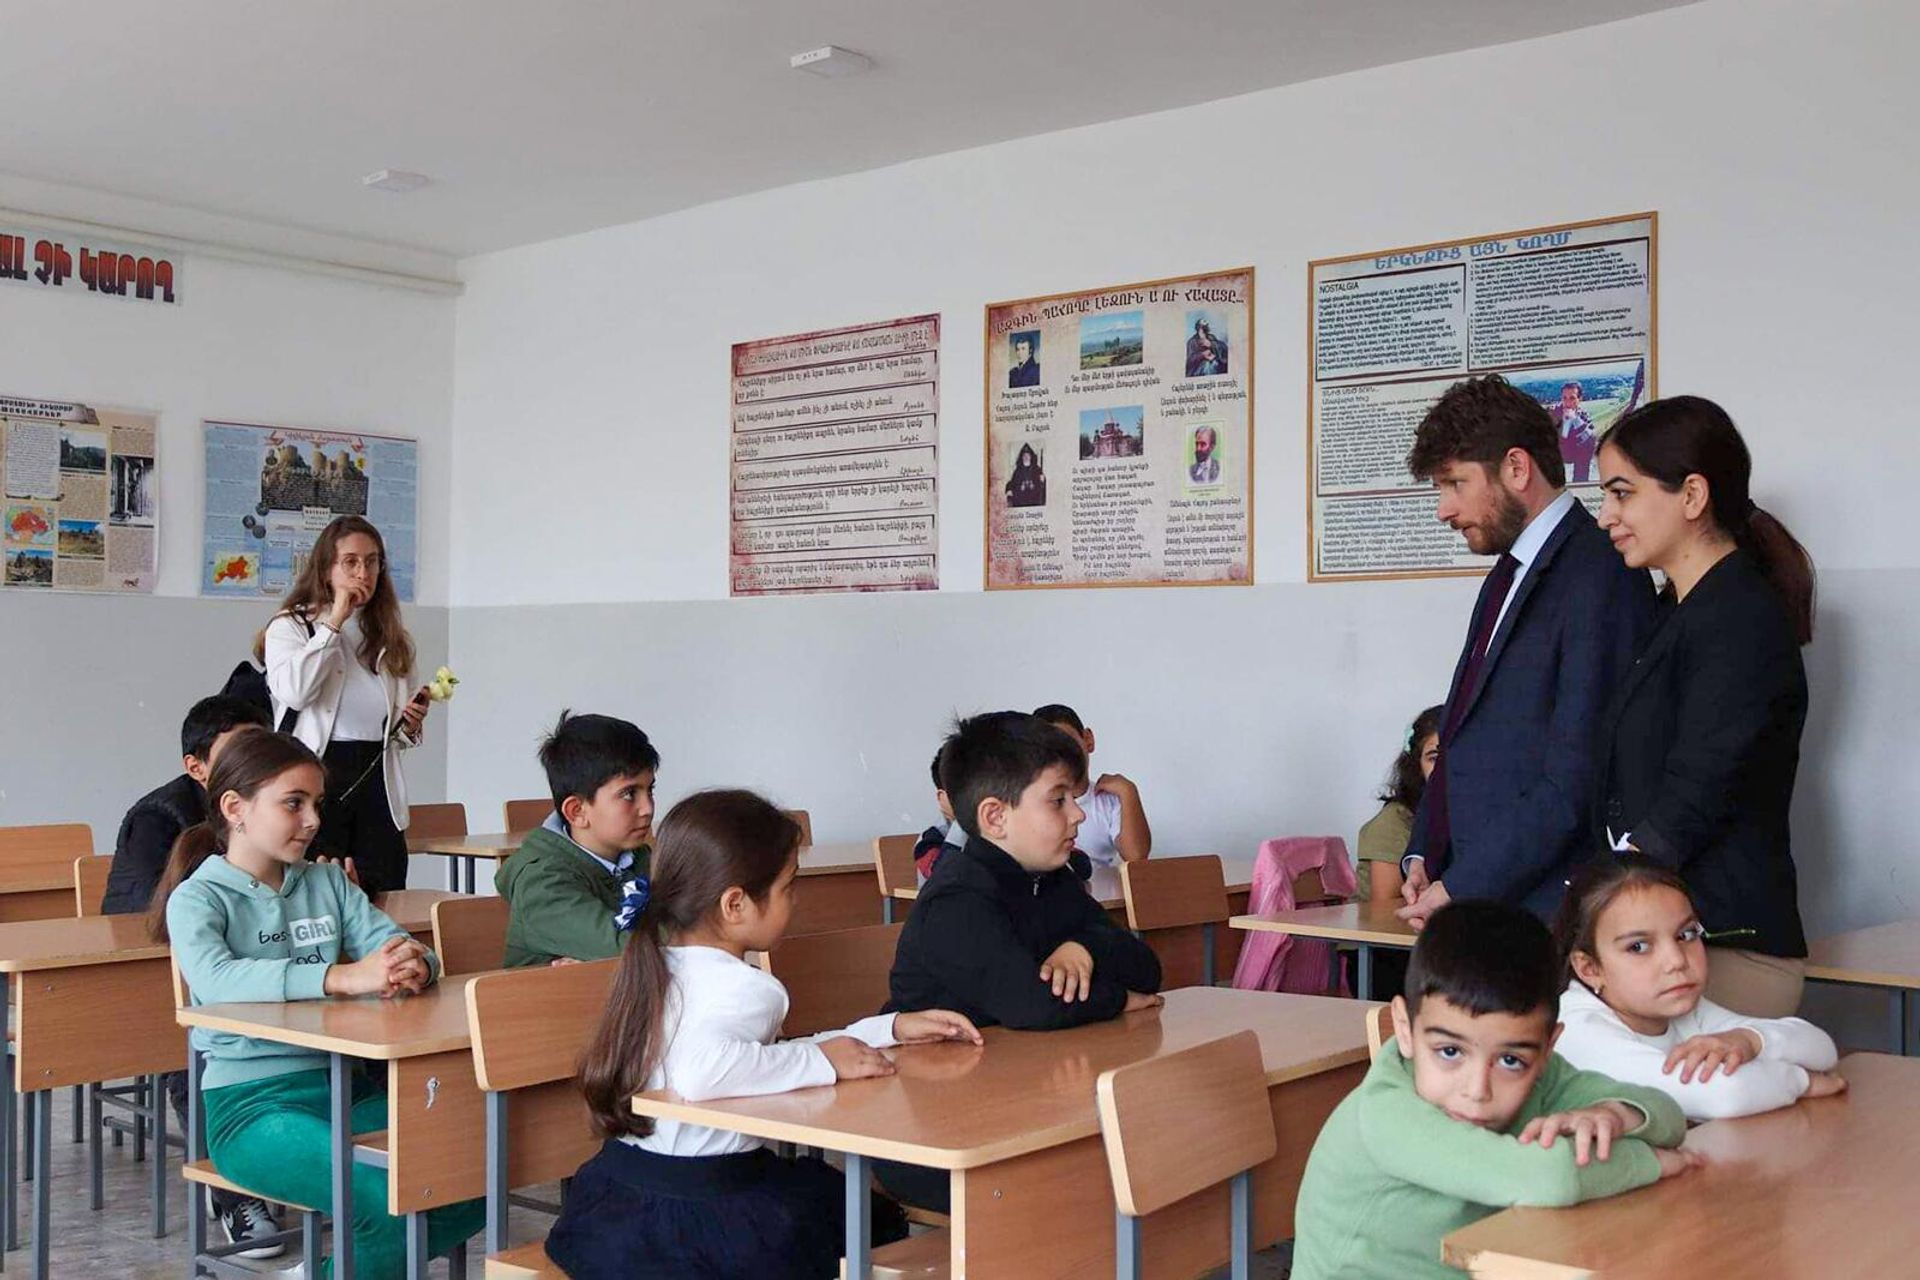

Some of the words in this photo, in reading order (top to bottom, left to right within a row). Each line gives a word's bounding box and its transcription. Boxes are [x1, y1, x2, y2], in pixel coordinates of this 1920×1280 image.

[34, 240, 72, 286] ՉԻ
[79, 247, 175, 303] ԿԱՐՈՂ
[1319, 281, 1359, 294] NOSTALGIA
[1094, 292, 1144, 310] ԼԵԶՈՒՆ
[1162, 289, 1179, 302] ՈՒ
